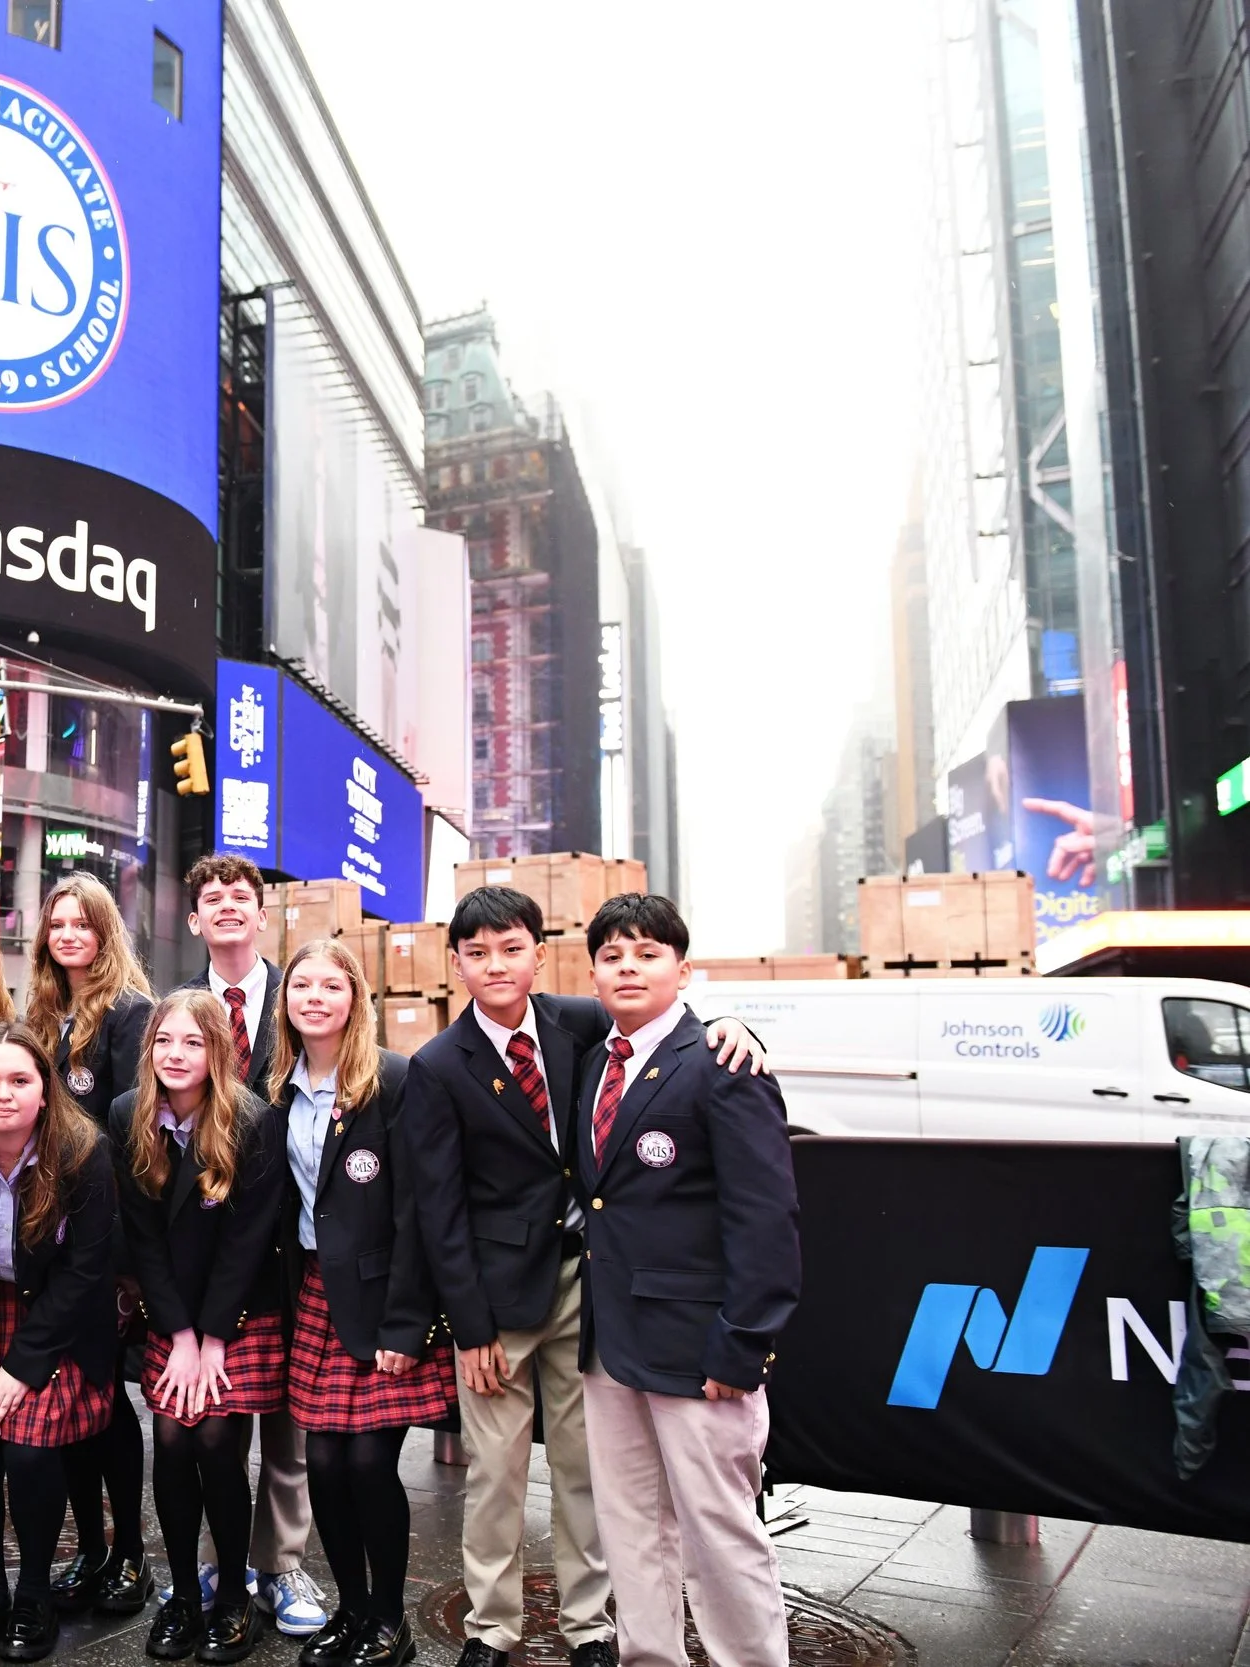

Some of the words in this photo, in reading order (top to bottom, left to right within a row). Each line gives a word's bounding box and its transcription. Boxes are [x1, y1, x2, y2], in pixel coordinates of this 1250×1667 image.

[40, 278, 120, 388] SCHOOL
[941, 1020, 1023, 1038] Johnson
[955, 1040, 1040, 1058] Controls
[73, 1077, 89, 1087] MIS
[645, 1146, 667, 1158] MIS
[353, 1161, 373, 1173] MIS
